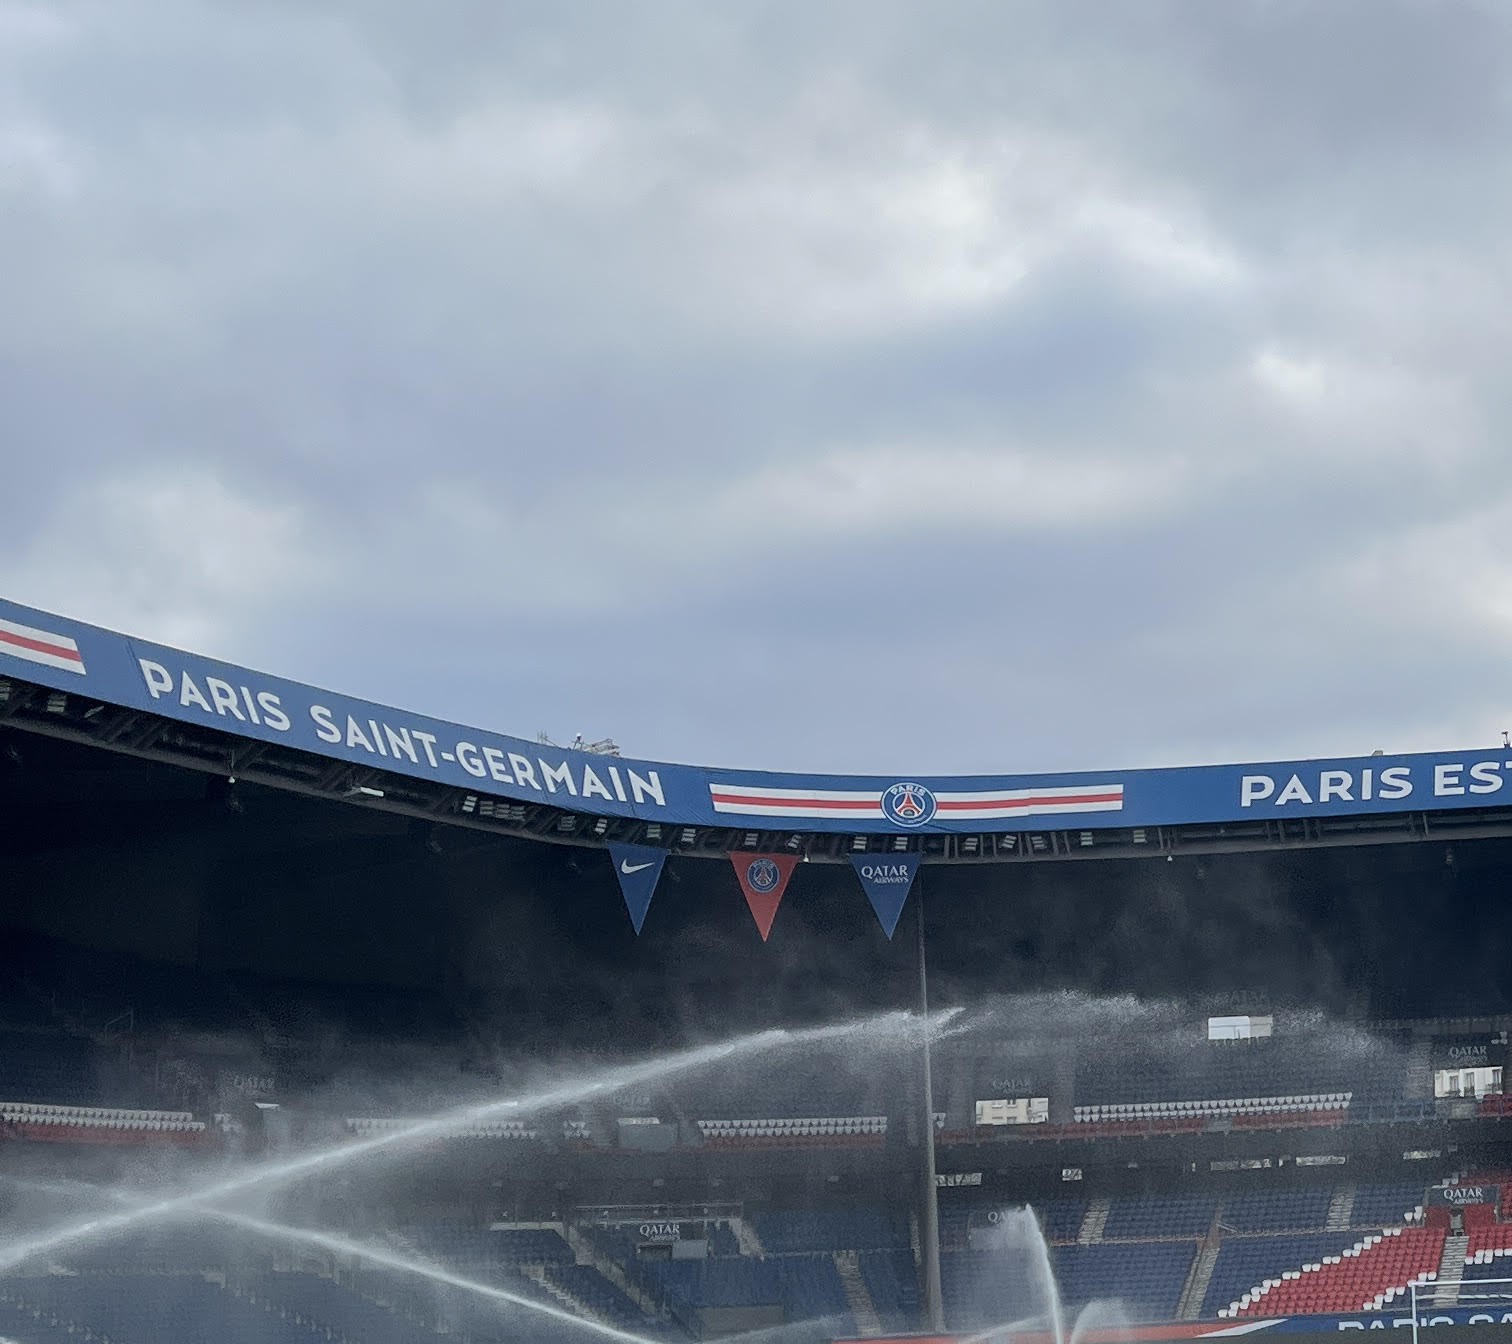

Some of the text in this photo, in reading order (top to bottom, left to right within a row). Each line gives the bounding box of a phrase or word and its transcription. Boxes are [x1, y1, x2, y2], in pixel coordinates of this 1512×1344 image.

[139, 658, 667, 807] PARIS SAINT-GERMAIN
[890, 784, 926, 797] PARIS
[1241, 767, 1413, 808] PARIS
[861, 865, 908, 879] QATAR
[1448, 1046, 1488, 1058] QATAR
[1443, 1187, 1483, 1201] QATAR
[640, 1223, 680, 1237] QATAR
